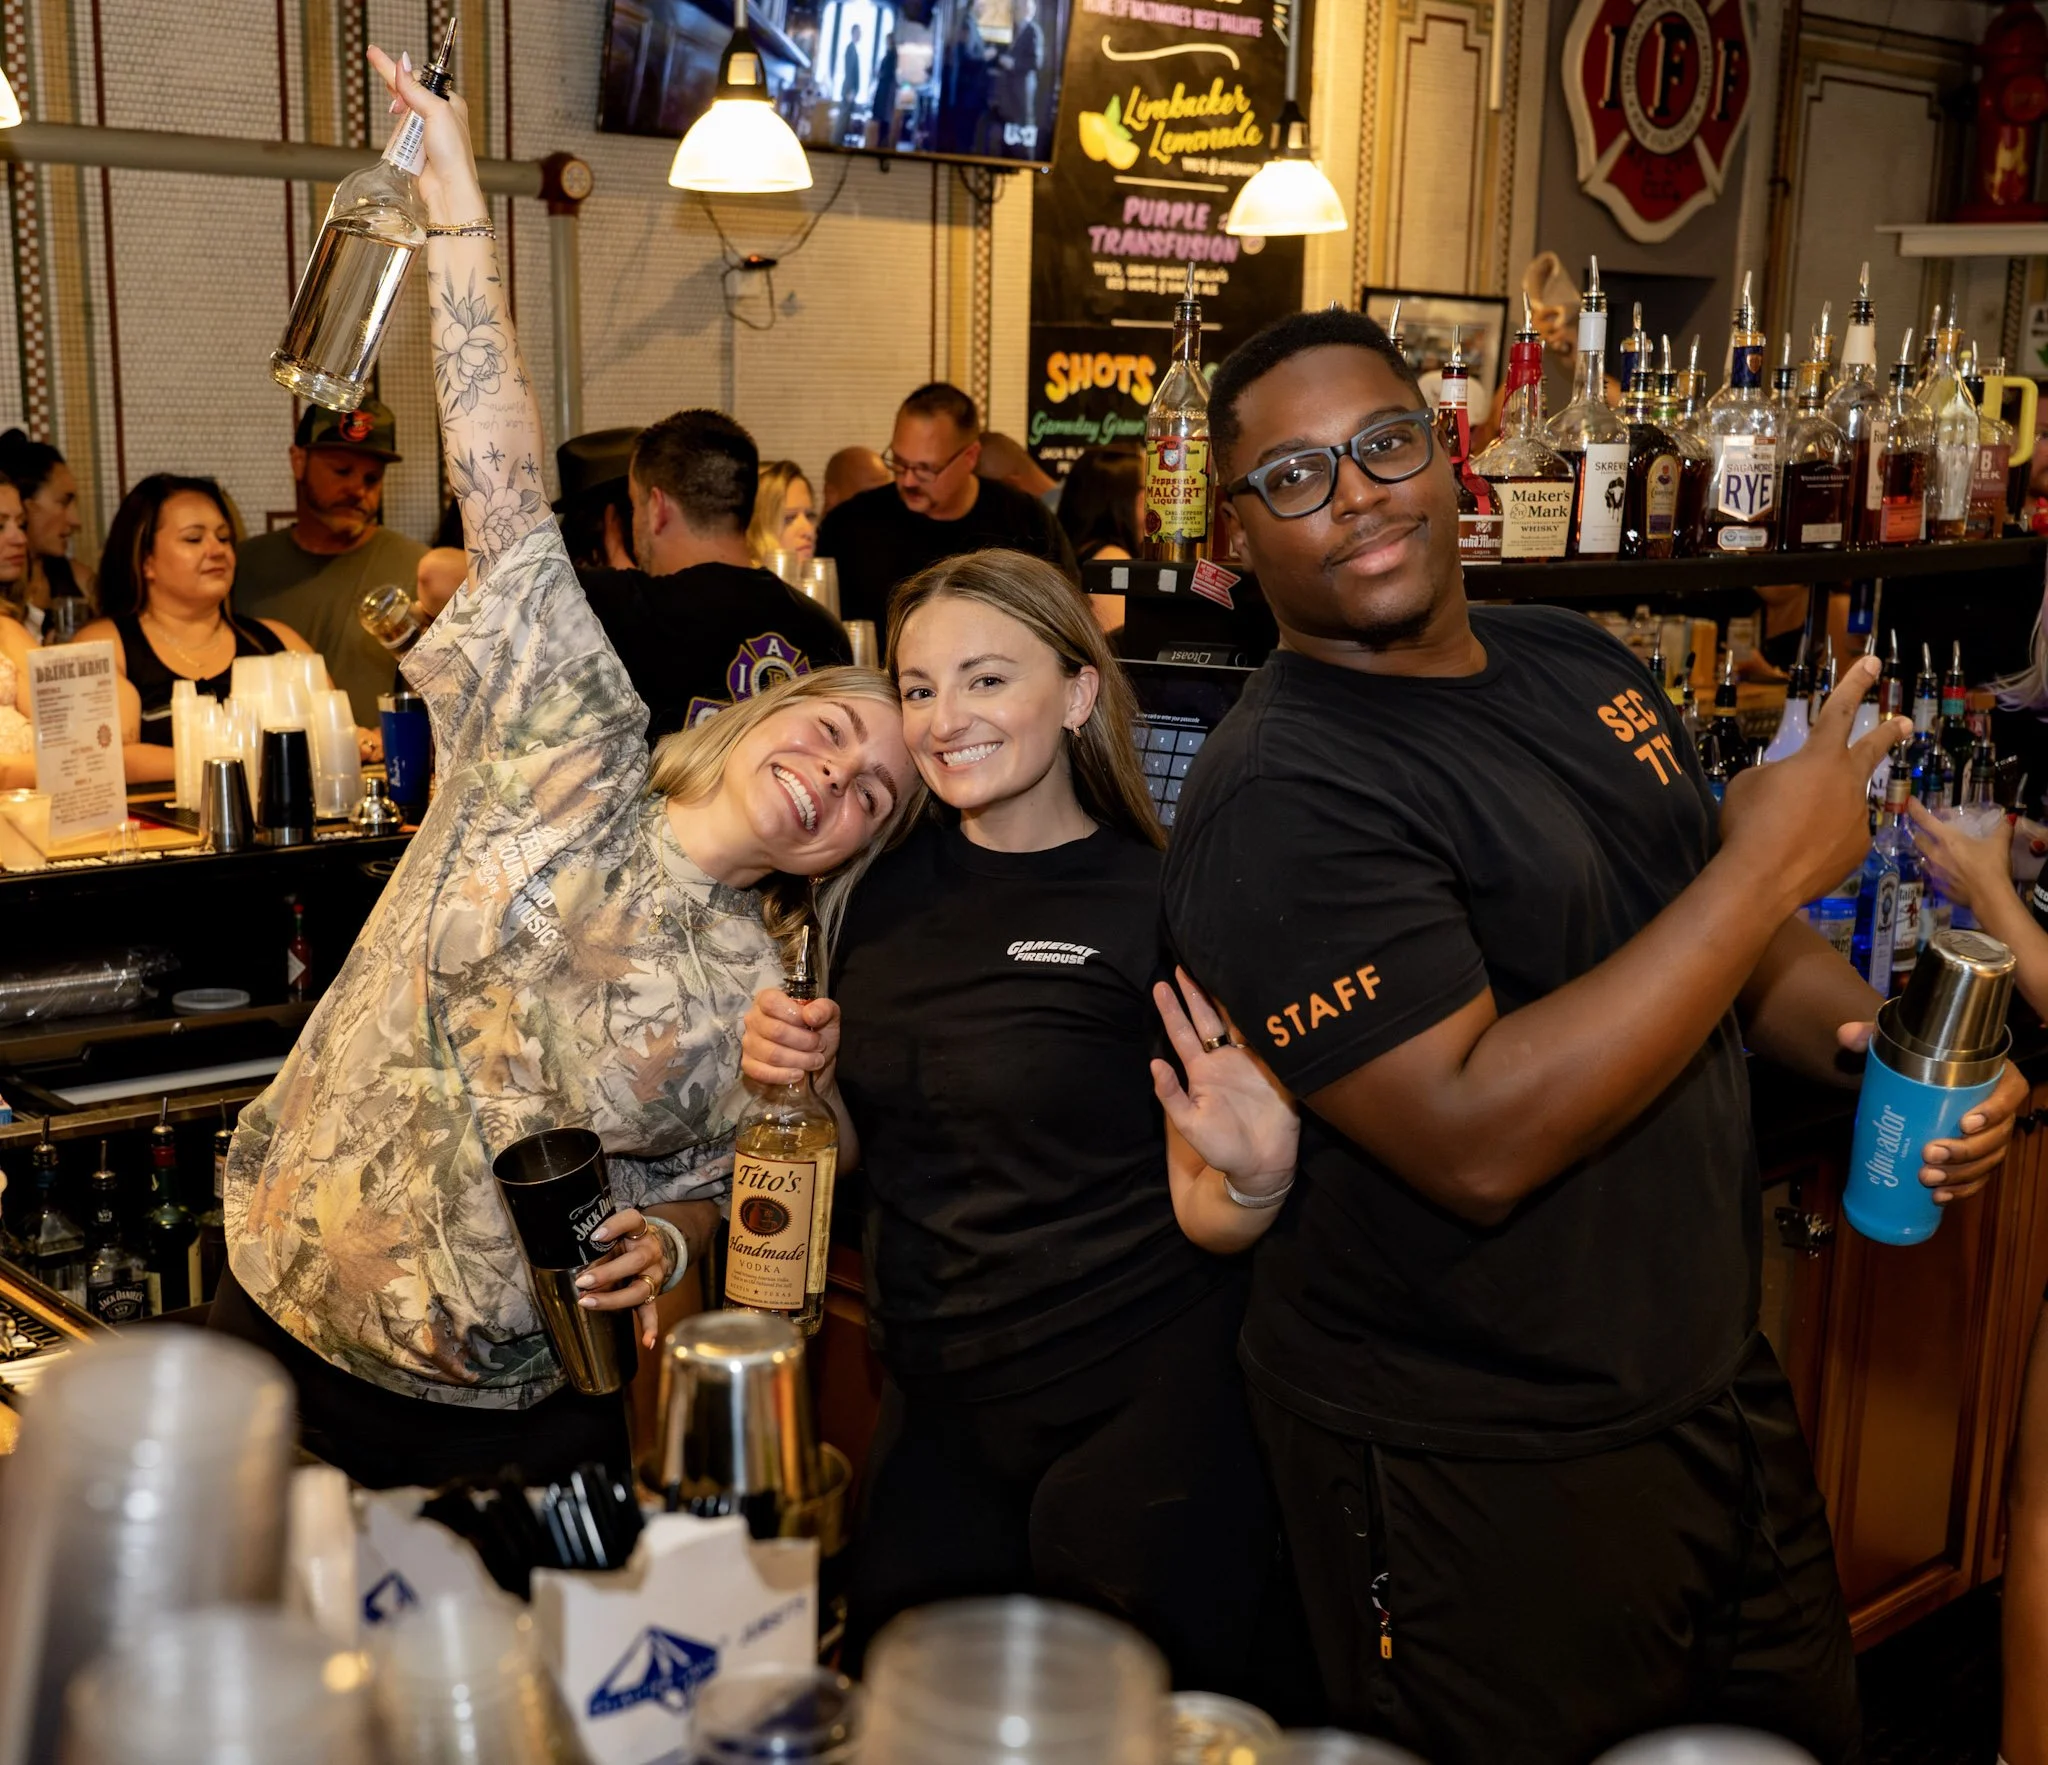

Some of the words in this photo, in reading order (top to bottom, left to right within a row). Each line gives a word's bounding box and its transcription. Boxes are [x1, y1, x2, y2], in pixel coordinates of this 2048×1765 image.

[1123, 195, 1211, 231] PURPLE
[1088, 225, 1240, 263] TRANSFUSION
[1045, 351, 1156, 406] SHOTS
[1029, 410, 1100, 446] Gameday
[1151, 475, 1197, 485] Jeppson's
[1726, 463, 1773, 473] SAGAMORE
[1511, 489, 1571, 502] Maker's
[1724, 474, 1773, 515] RYE
[1528, 505, 1568, 518] Mark
[1171, 651, 1199, 661] toast
[1597, 688, 1658, 742] SEC
[511, 893, 559, 947] MUSIC
[1007, 941, 1101, 957] GAMEDAY
[1014, 952, 1086, 965] FIREHOUSE
[1266, 965, 1381, 1047] STAFF
[738, 1164, 801, 1193] Tito's
[572, 1209, 602, 1241] JACK
[729, 1235, 805, 1261] Handmade
[739, 1259, 781, 1274] VODKA
[98, 1294, 116, 1311] JACK
